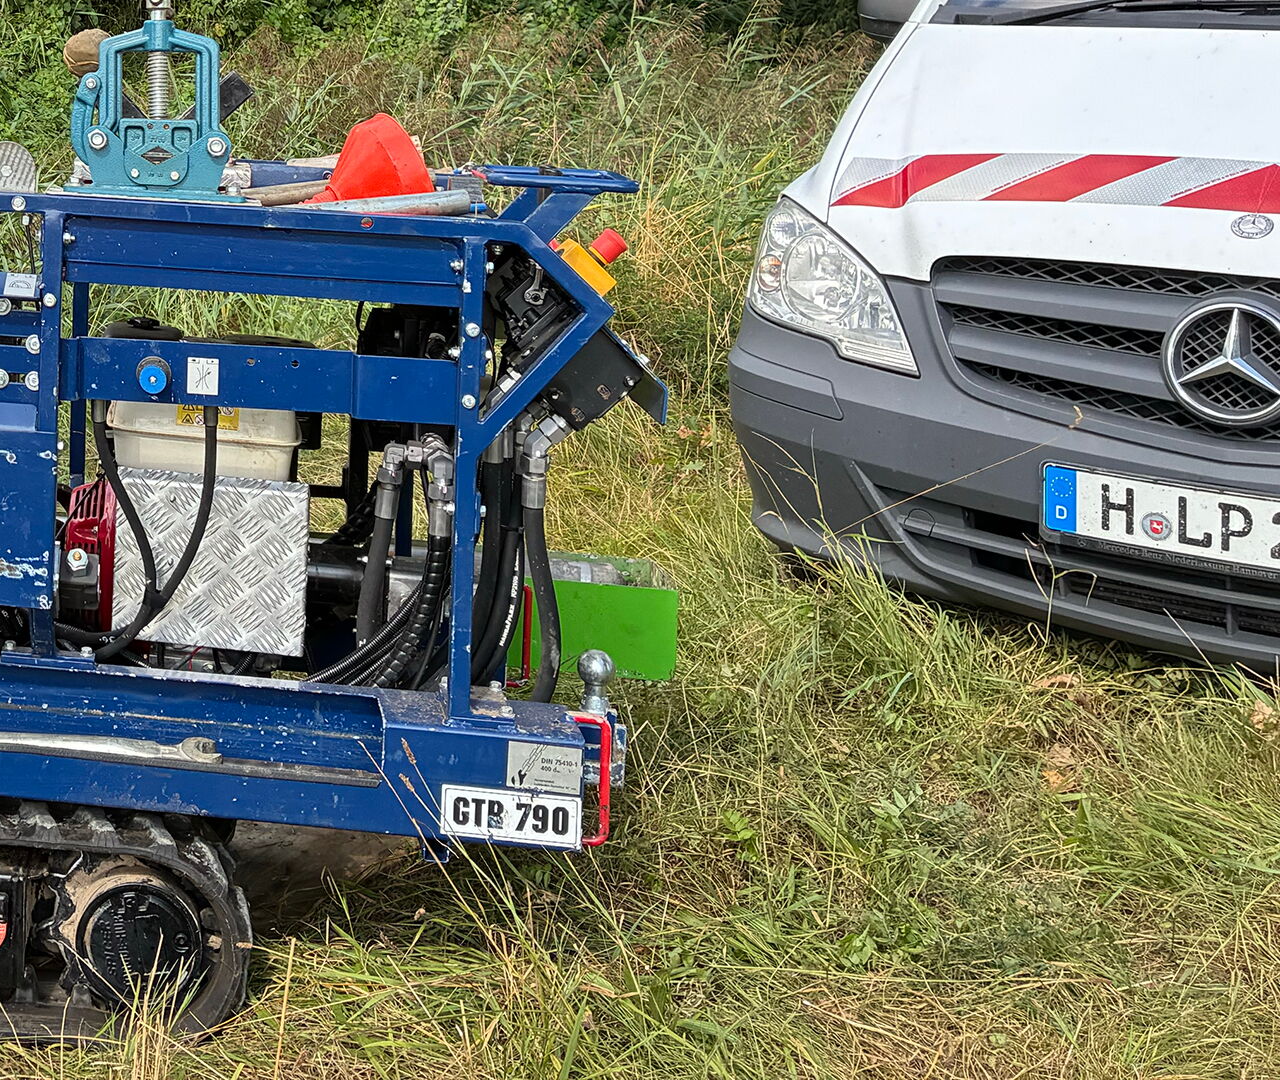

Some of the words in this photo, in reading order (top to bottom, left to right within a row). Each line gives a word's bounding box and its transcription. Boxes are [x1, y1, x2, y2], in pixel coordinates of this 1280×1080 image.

[1055, 505, 1067, 520] D
[1101, 483, 1134, 535] H
[1178, 496, 1253, 552] LP
[1165, 552, 1230, 572] Niederlassung
[1232, 563, 1279, 580] Hannover
[555, 759, 578, 767] 75410-1
[515, 802, 569, 836] 790
